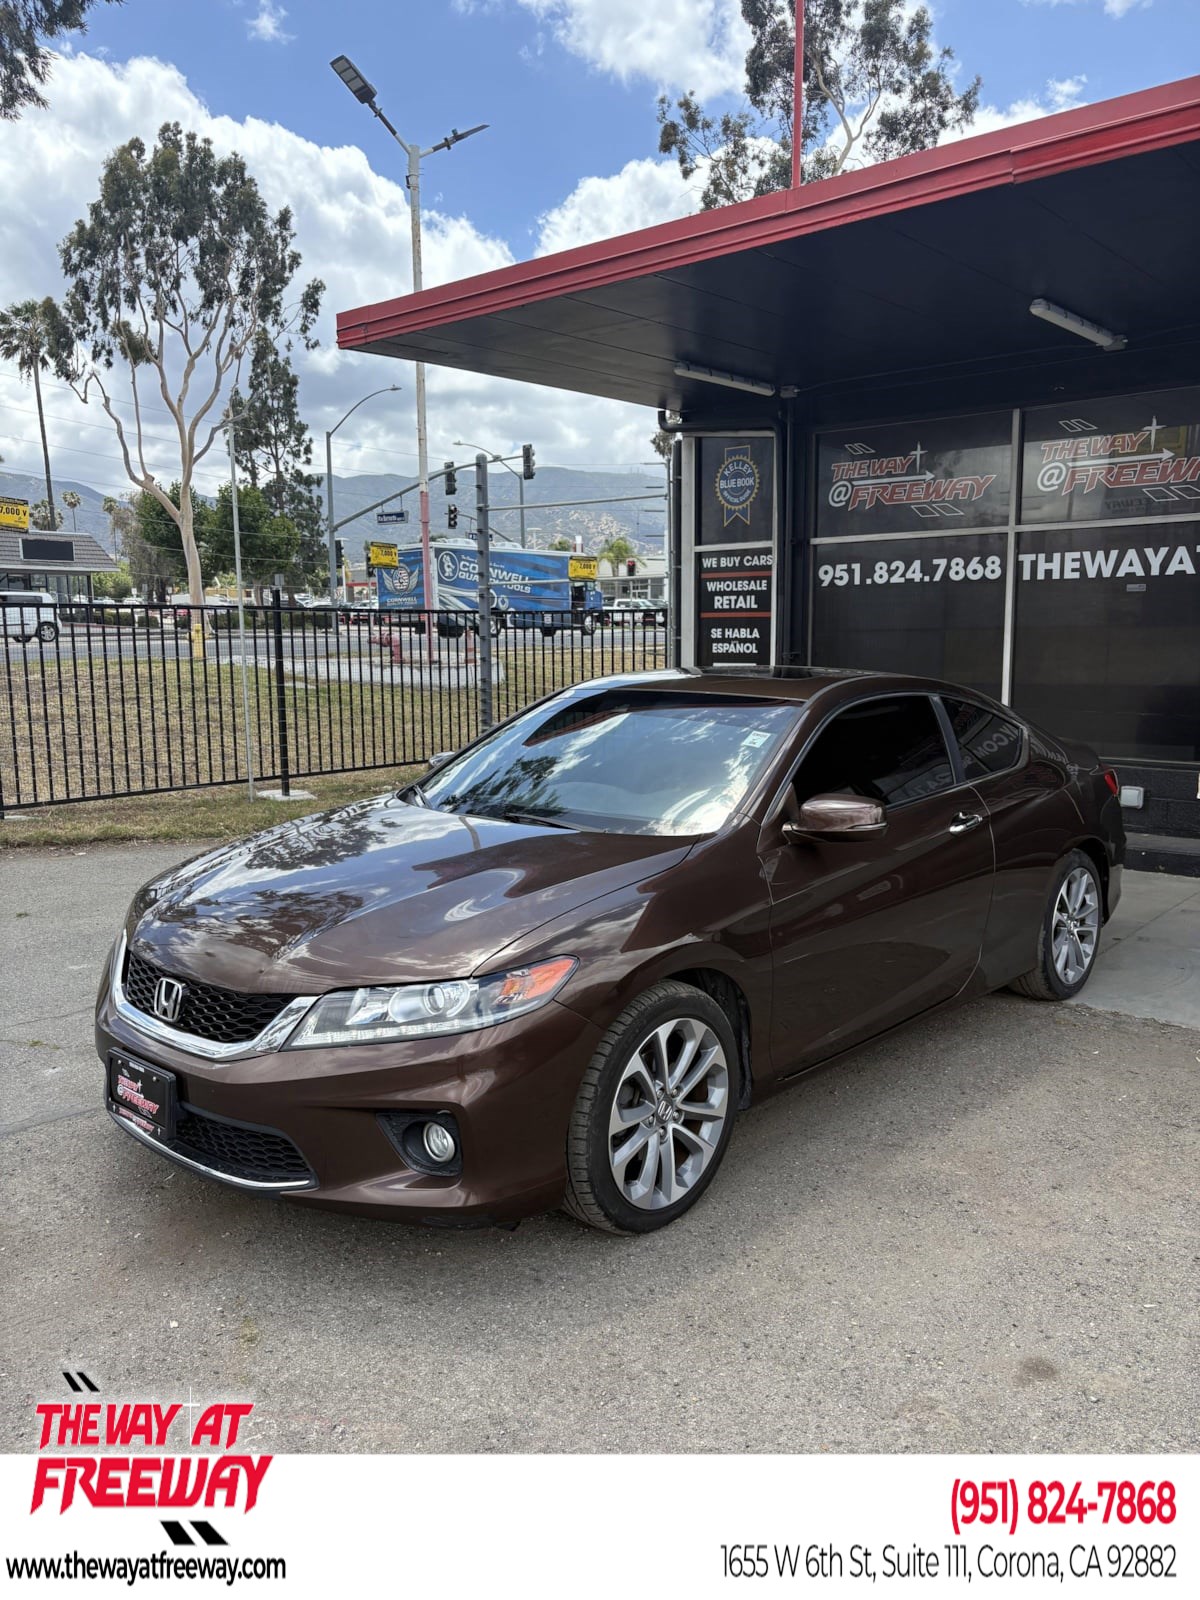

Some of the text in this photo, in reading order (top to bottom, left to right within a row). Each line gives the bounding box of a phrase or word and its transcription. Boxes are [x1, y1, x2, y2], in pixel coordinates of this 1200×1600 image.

[1041, 431, 1150, 464] THE WAY
[723, 461, 753, 477] KELLEY
[831, 455, 915, 482] THE WAY
[720, 477, 755, 489] BLUE BOOK
[828, 474, 997, 512] @FREEWAY
[702, 554, 774, 568] WE BUY CARS
[1018, 545, 1200, 581] THEWAYA
[818, 556, 1002, 587] 951.824.7868
[706, 580, 768, 592] WHOLESALE
[714, 595, 758, 609] RETAIL
[710, 628, 760, 639] SE HABLA
[712, 641, 758, 653] ESPAÑOL
